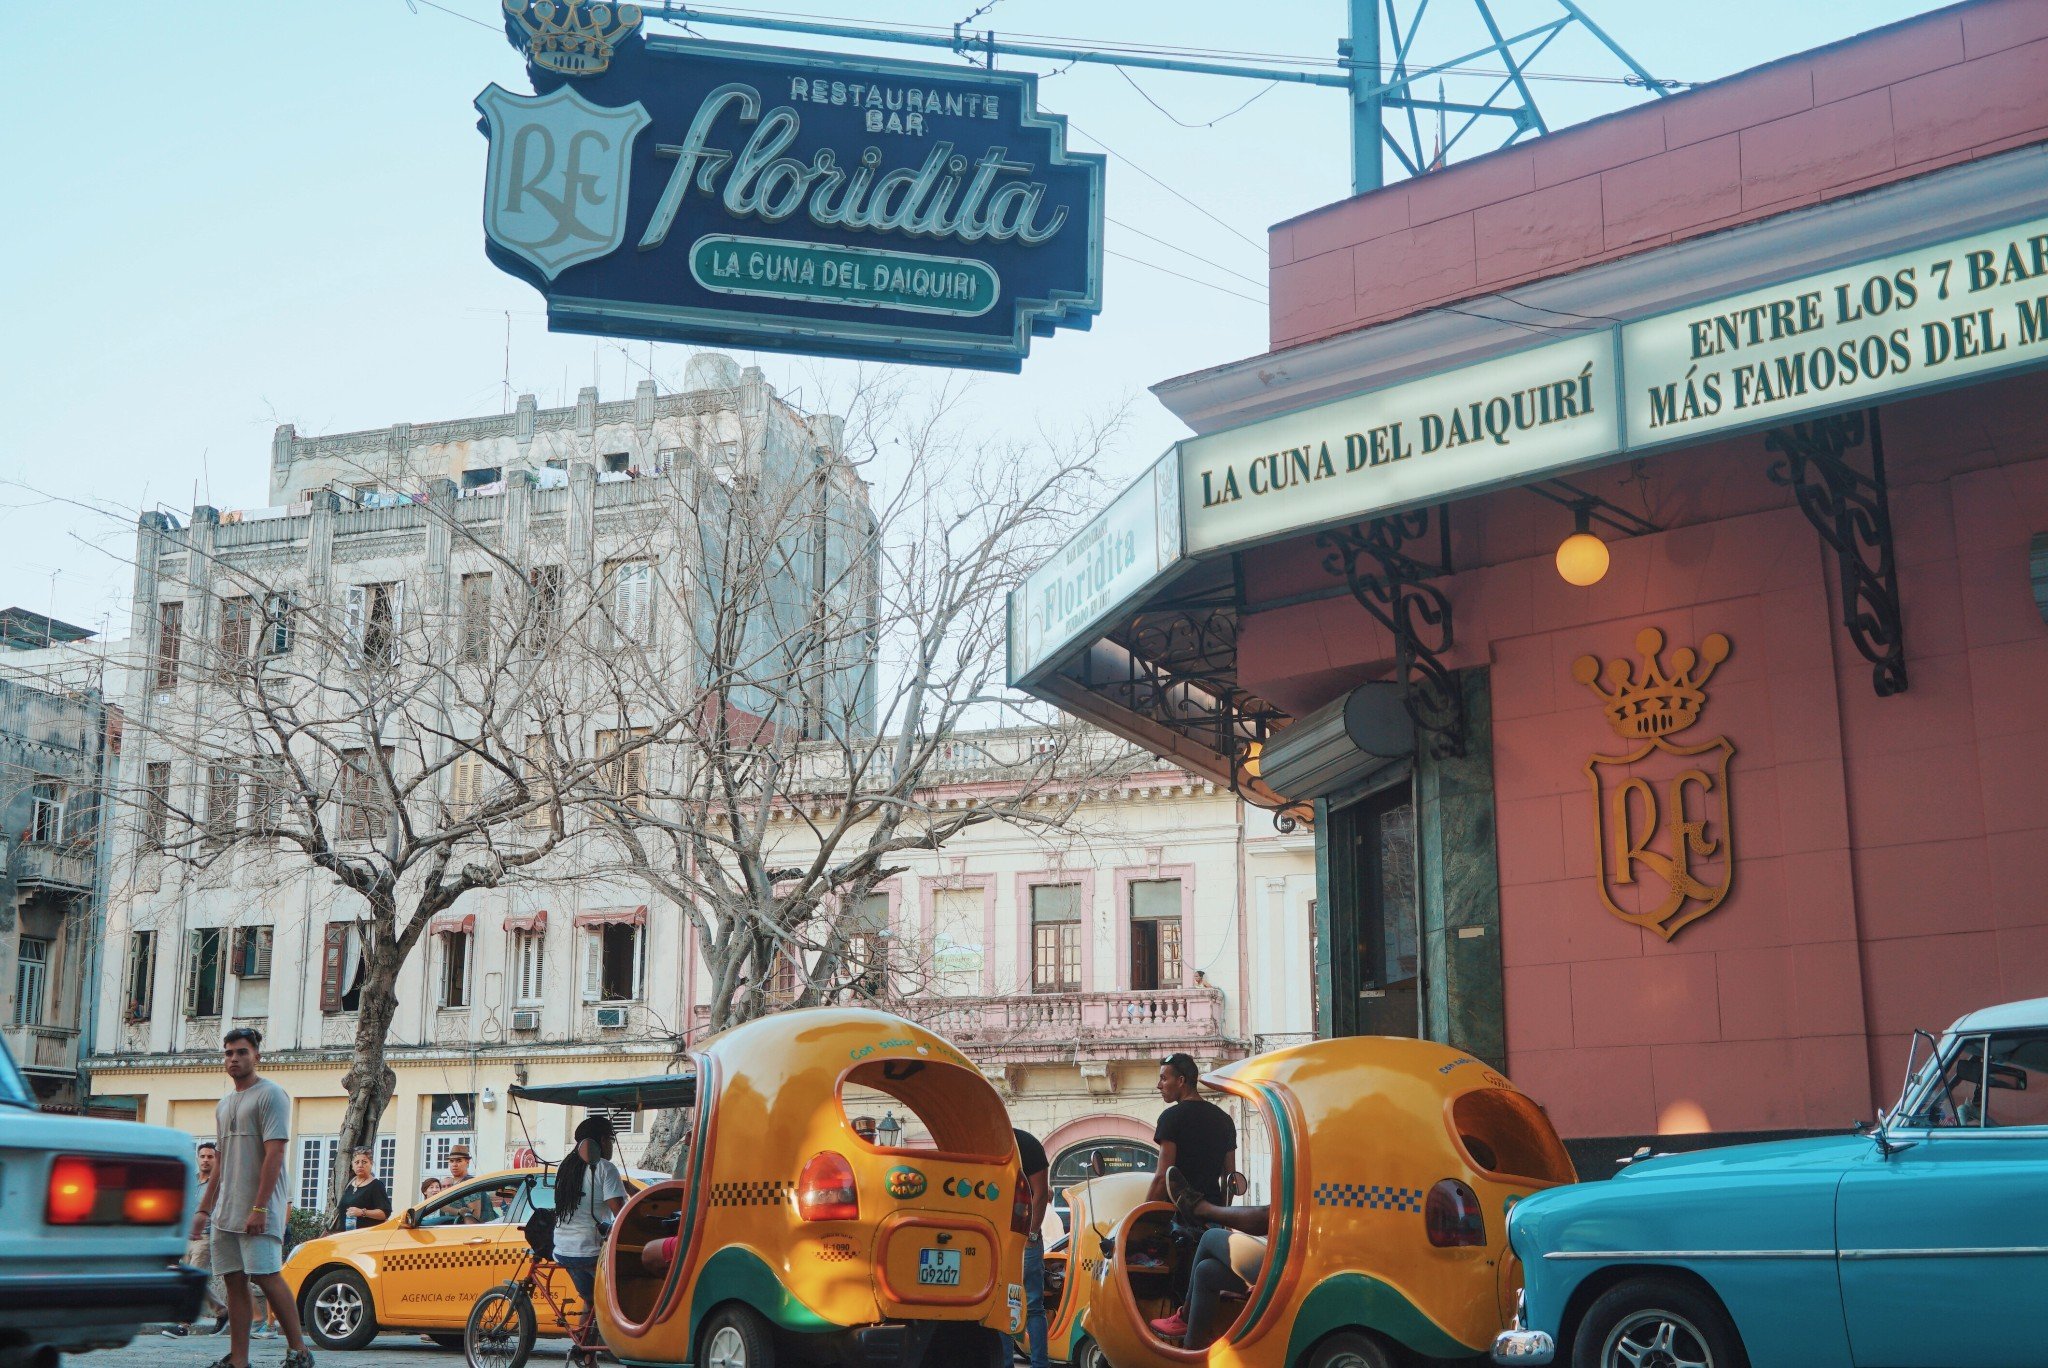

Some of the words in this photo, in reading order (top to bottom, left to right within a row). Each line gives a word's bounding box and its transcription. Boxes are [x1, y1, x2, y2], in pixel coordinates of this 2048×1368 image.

[790, 76, 1000, 120] RESTAURANTE
[866, 109, 924, 137] BAR
[713, 250, 740, 278] LA
[749, 251, 815, 285] CUNA
[821, 260, 868, 290] DEL
[873, 264, 977, 301] DAIQUIRI
[1688, 291, 1824, 361] ENTRE
[1835, 267, 1918, 326] LOS
[1930, 259, 1953, 300] 7
[1648, 363, 1723, 429] MÁS
[1732, 327, 1911, 410] FAMOSOS
[1921, 308, 2006, 368] DEL
[1201, 466, 1242, 508] LA
[1248, 441, 1336, 497] CUNA
[1344, 421, 1412, 473] DEL
[1419, 360, 1595, 455] DAIQUIRÍ
[1044, 529, 1136, 632] Floridita
[437, 1115, 469, 1126] adidas
[943, 1176, 1000, 1202] COCO
[937, 1251, 945, 1266] B
[965, 1247, 976, 1256] 103
[921, 1268, 958, 1284] 09207
[401, 1293, 443, 1304] AGENCIA
[445, 1293, 456, 1302] de
